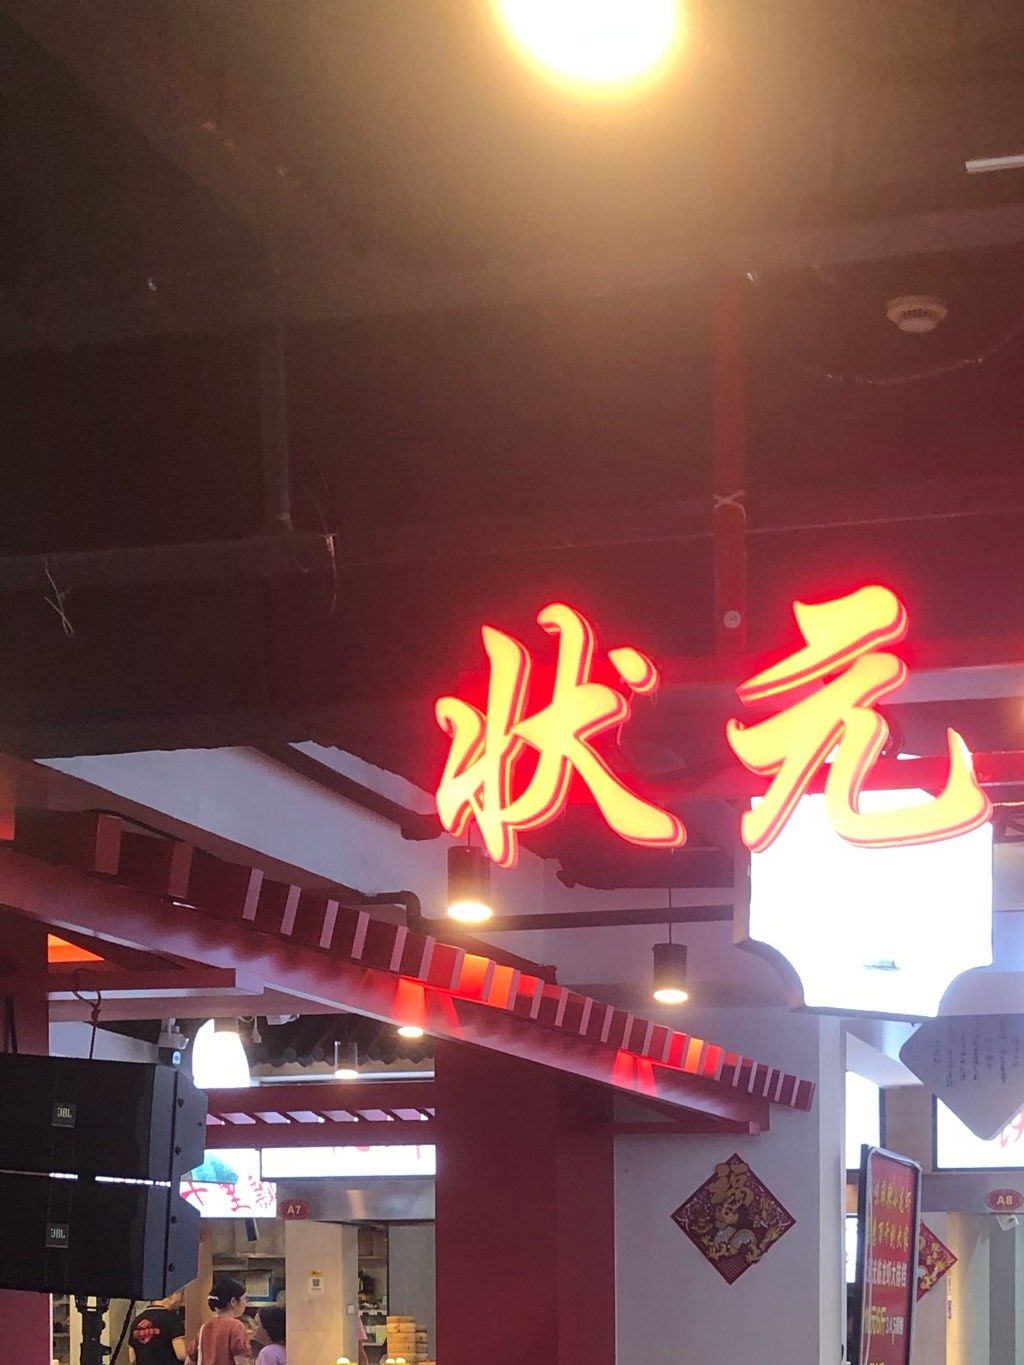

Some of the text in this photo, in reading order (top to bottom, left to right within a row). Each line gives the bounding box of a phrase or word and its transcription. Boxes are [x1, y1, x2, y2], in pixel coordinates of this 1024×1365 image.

[57, 1106, 72, 1118] JBL
[996, 1194, 1014, 1206] A8
[286, 1204, 302, 1215] A7
[50, 1227, 66, 1239] JBL
